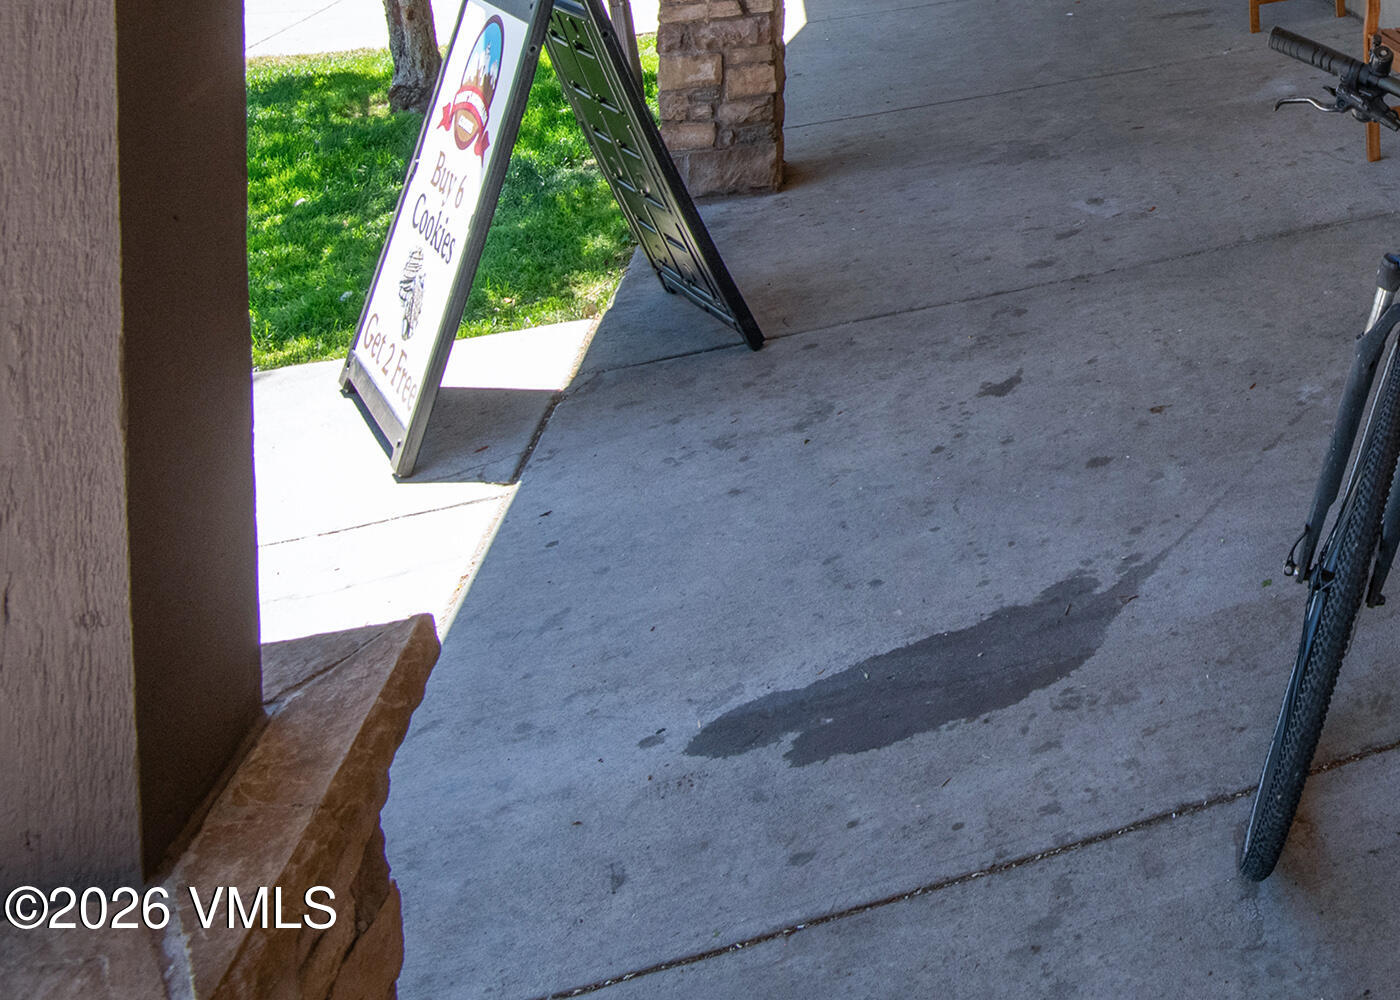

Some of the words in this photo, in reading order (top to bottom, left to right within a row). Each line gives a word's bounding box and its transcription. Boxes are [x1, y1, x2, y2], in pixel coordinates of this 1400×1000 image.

[431, 150, 457, 207] Buy
[455, 175, 468, 209] 6
[412, 193, 456, 264] Cookies
[364, 313, 387, 365] Get
[381, 343, 396, 376] 2
[390, 349, 417, 411] Free
